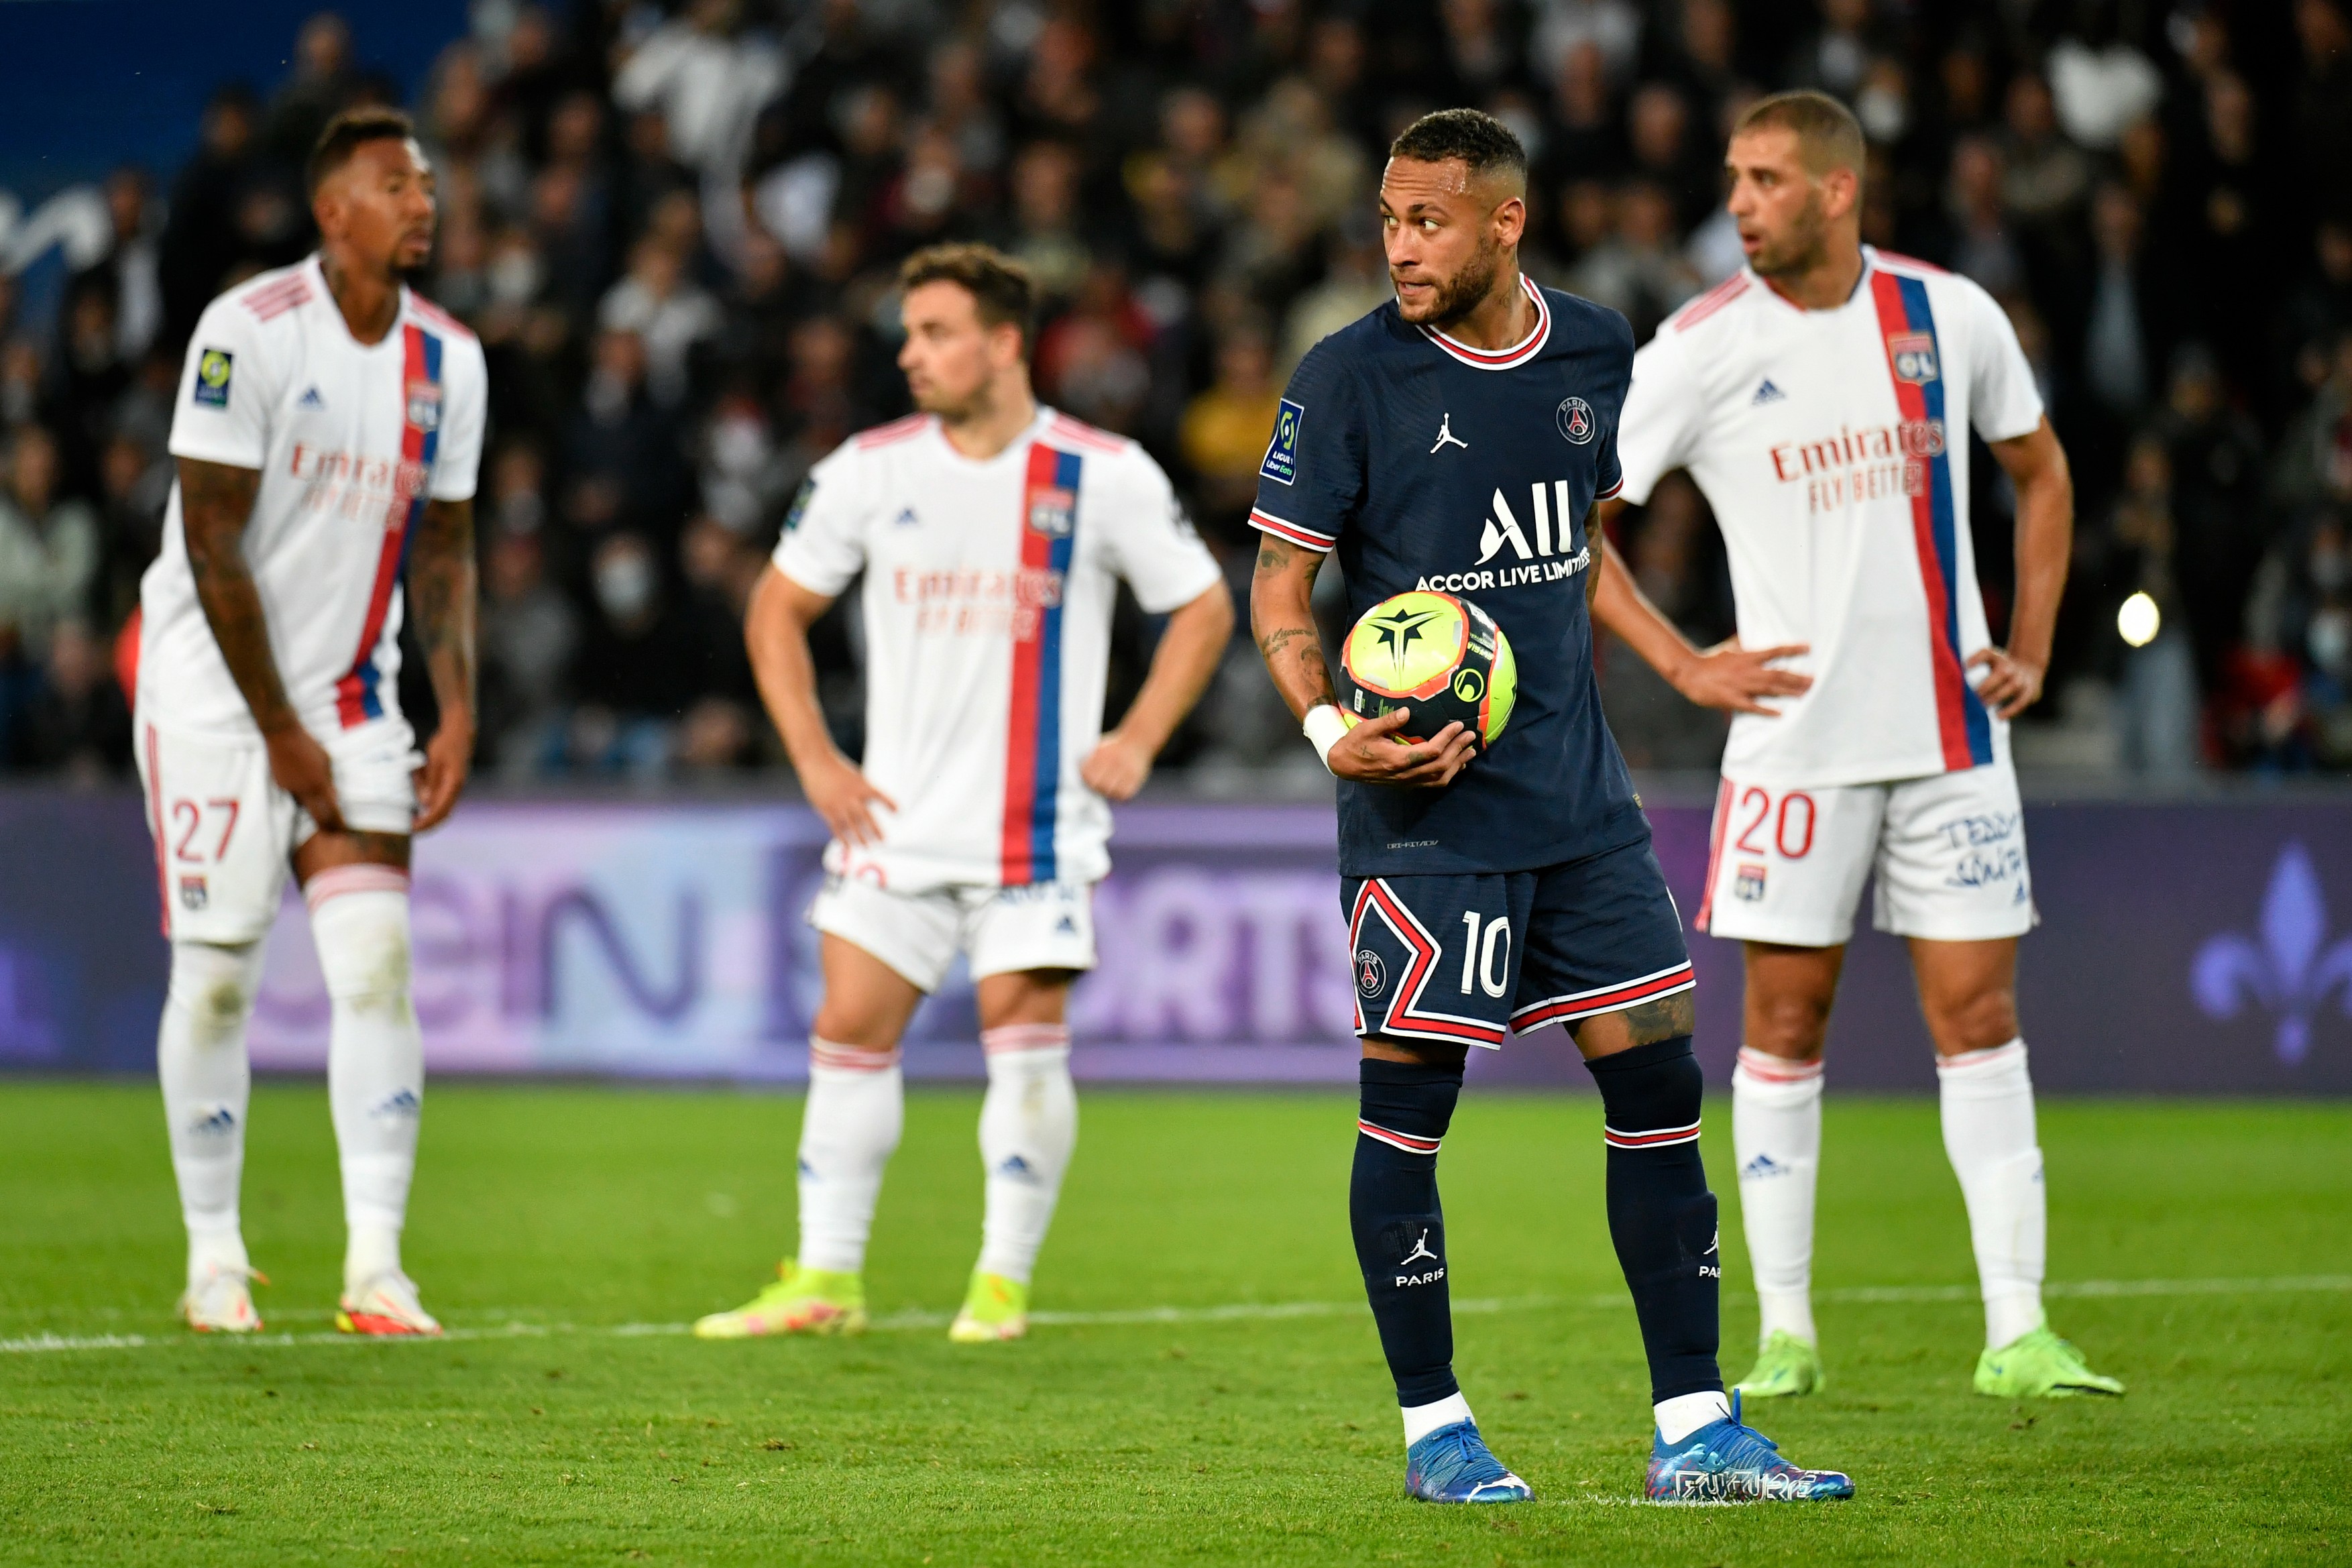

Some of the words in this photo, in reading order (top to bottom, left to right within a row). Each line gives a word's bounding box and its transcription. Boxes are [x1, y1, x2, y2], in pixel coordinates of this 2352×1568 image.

[1561, 400, 1587, 412] PARIS
[1272, 450, 1290, 464] LIGUE
[1769, 418, 1946, 484] Emirates
[1266, 459, 1281, 471] Uber
[1279, 465, 1292, 476] Eats
[1414, 570, 1496, 592] ACCOR
[1500, 564, 1543, 587] LIVE
[172, 796, 241, 863] 27
[1736, 786, 1817, 860] 20
[1357, 952, 1378, 964] PARIS
[1460, 910, 1511, 998] 10
[1396, 1268, 1444, 1287] PARIS
